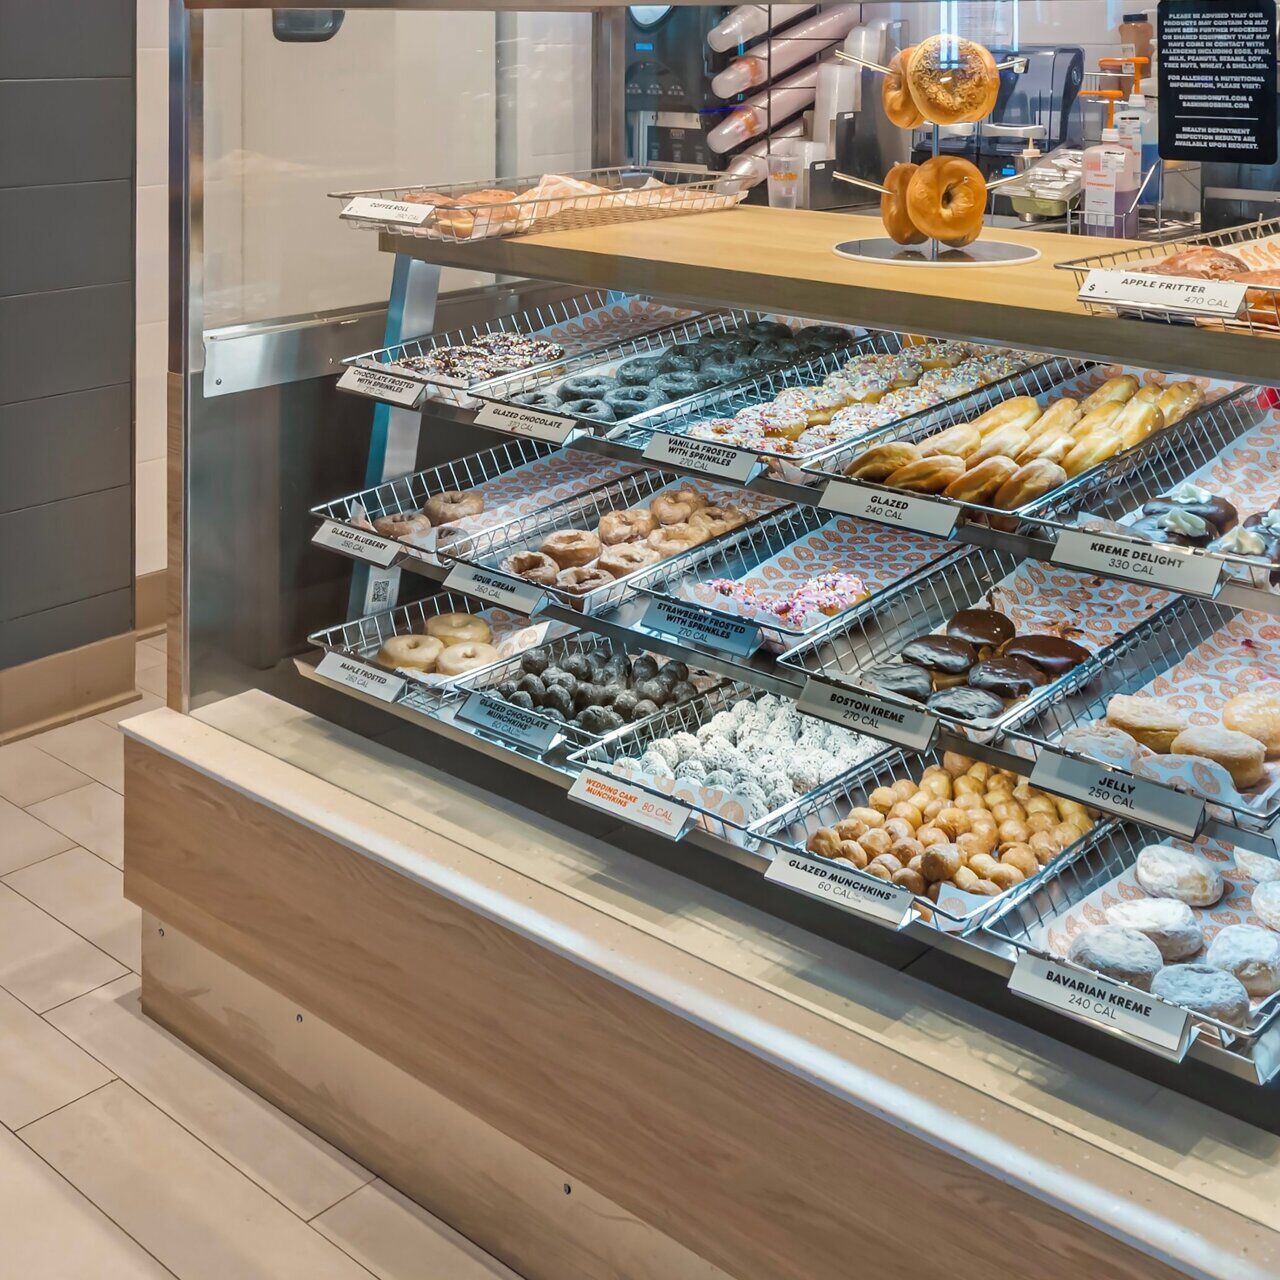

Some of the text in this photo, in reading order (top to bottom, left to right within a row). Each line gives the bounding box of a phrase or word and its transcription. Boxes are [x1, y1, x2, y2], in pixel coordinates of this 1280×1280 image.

[1121, 278, 1206, 294] APPLE FRITTER
[1184, 296, 1204, 305] 470
[1207, 298, 1229, 308] CAL
[354, 370, 388, 383] CHOCOLATE
[493, 408, 562, 428] GLAZED CHOCOLATE
[668, 438, 737, 459] VANILLA FROSTED
[668, 446, 731, 466] WITH SPRINKLES
[679, 459, 709, 471] 270 CAL
[865, 505, 903, 520] 240 CAL
[870, 495, 908, 510] GLAZED
[331, 527, 388, 550] GLAZED BLUEBERRY
[1090, 542, 1184, 569] KREME DELIGHT
[1109, 558, 1155, 575] 330 CAL
[472, 574, 516, 593] SOUR CREAM
[657, 603, 745, 634] STRAWBERRY FROSTED
[666, 614, 730, 639] WITH SPRINKLES
[693, 632, 707, 642] CAL
[340, 662, 387, 684] MAPLE FROSTED
[480, 699, 549, 730] GLAZED CHOCOLATE
[830, 693, 905, 723] BOSTON KREME
[843, 710, 879, 728] 270 CAL
[586, 778, 638, 803] WEDDING CAKE
[1099, 777, 1136, 794] JELLY
[586, 787, 627, 807] MUNCHKINS
[641, 802, 654, 812] 80
[655, 807, 673, 821] CAL
[1088, 786, 1135, 809] 250 CAL
[789, 860, 827, 878] GLAZED
[818, 881, 831, 891] 60
[833, 886, 851, 899] CAL
[1046, 970, 1152, 1017] BAVARIAN KREME
[1069, 994, 1117, 1019] 240 CAL
